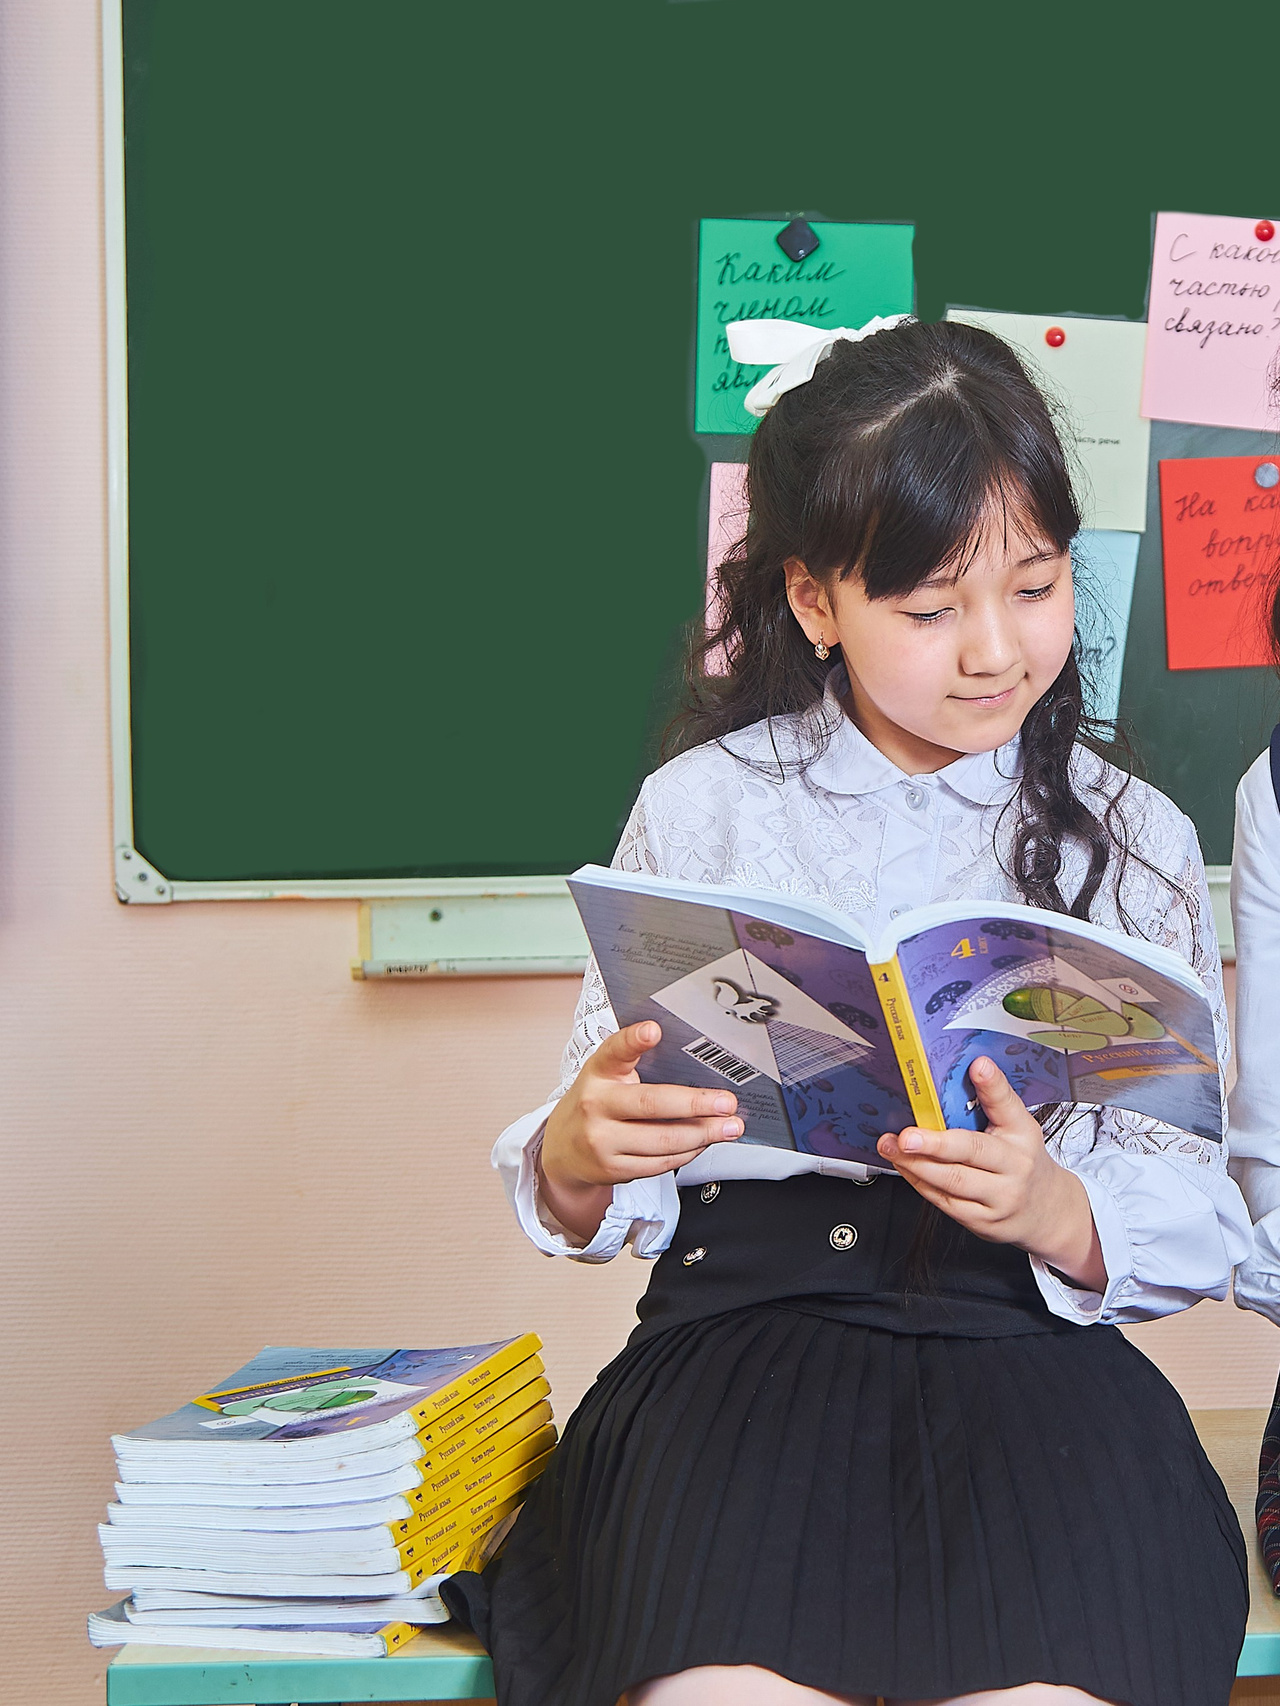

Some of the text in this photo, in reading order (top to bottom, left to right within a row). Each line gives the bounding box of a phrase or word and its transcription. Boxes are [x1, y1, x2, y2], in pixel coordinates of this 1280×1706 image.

[1170, 234, 1198, 262] С
[716, 252, 846, 284] Каким
[1169, 278, 1270, 298] частью
[714, 296, 836, 322] членом
[1175, 492, 1216, 521] На
[951, 938, 976, 959] 4
[879, 972, 890, 982] 4
[886, 997, 902, 1024] Русский
[1082, 1048, 1142, 1063] Русский
